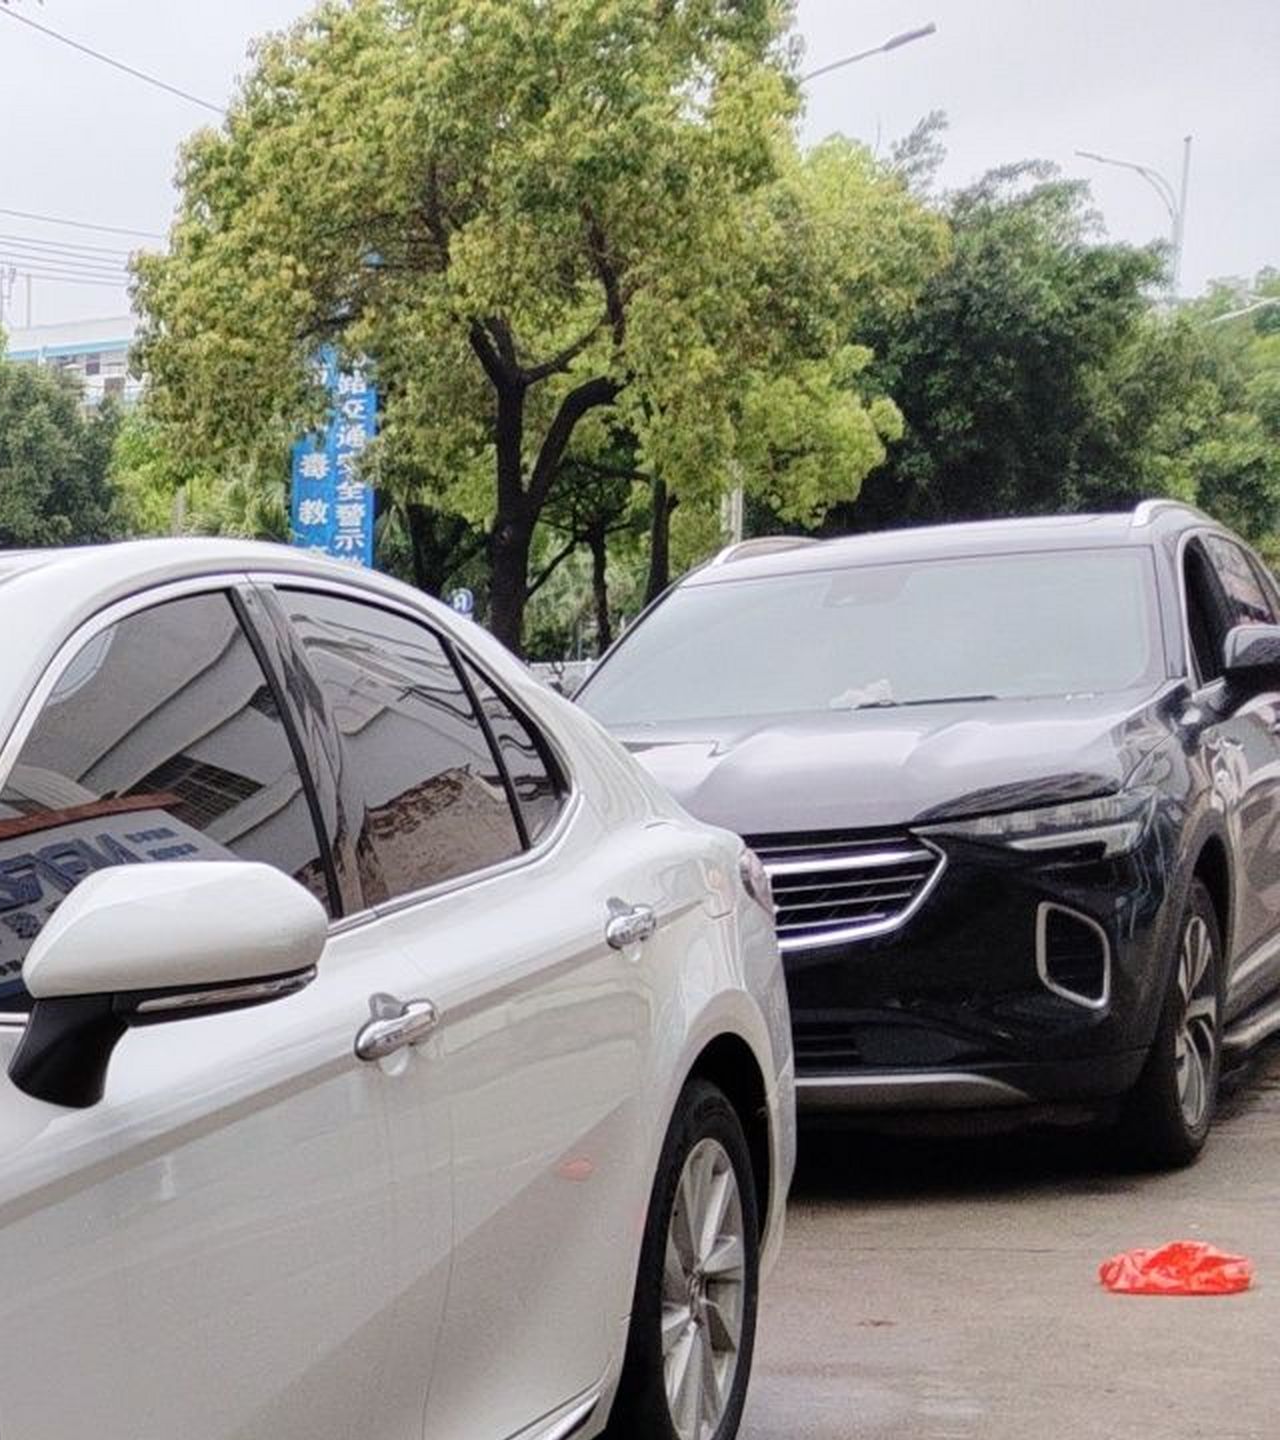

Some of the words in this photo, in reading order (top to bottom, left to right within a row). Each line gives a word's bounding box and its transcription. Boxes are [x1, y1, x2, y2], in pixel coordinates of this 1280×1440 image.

[335, 352, 368, 567] 路交通安全警示
